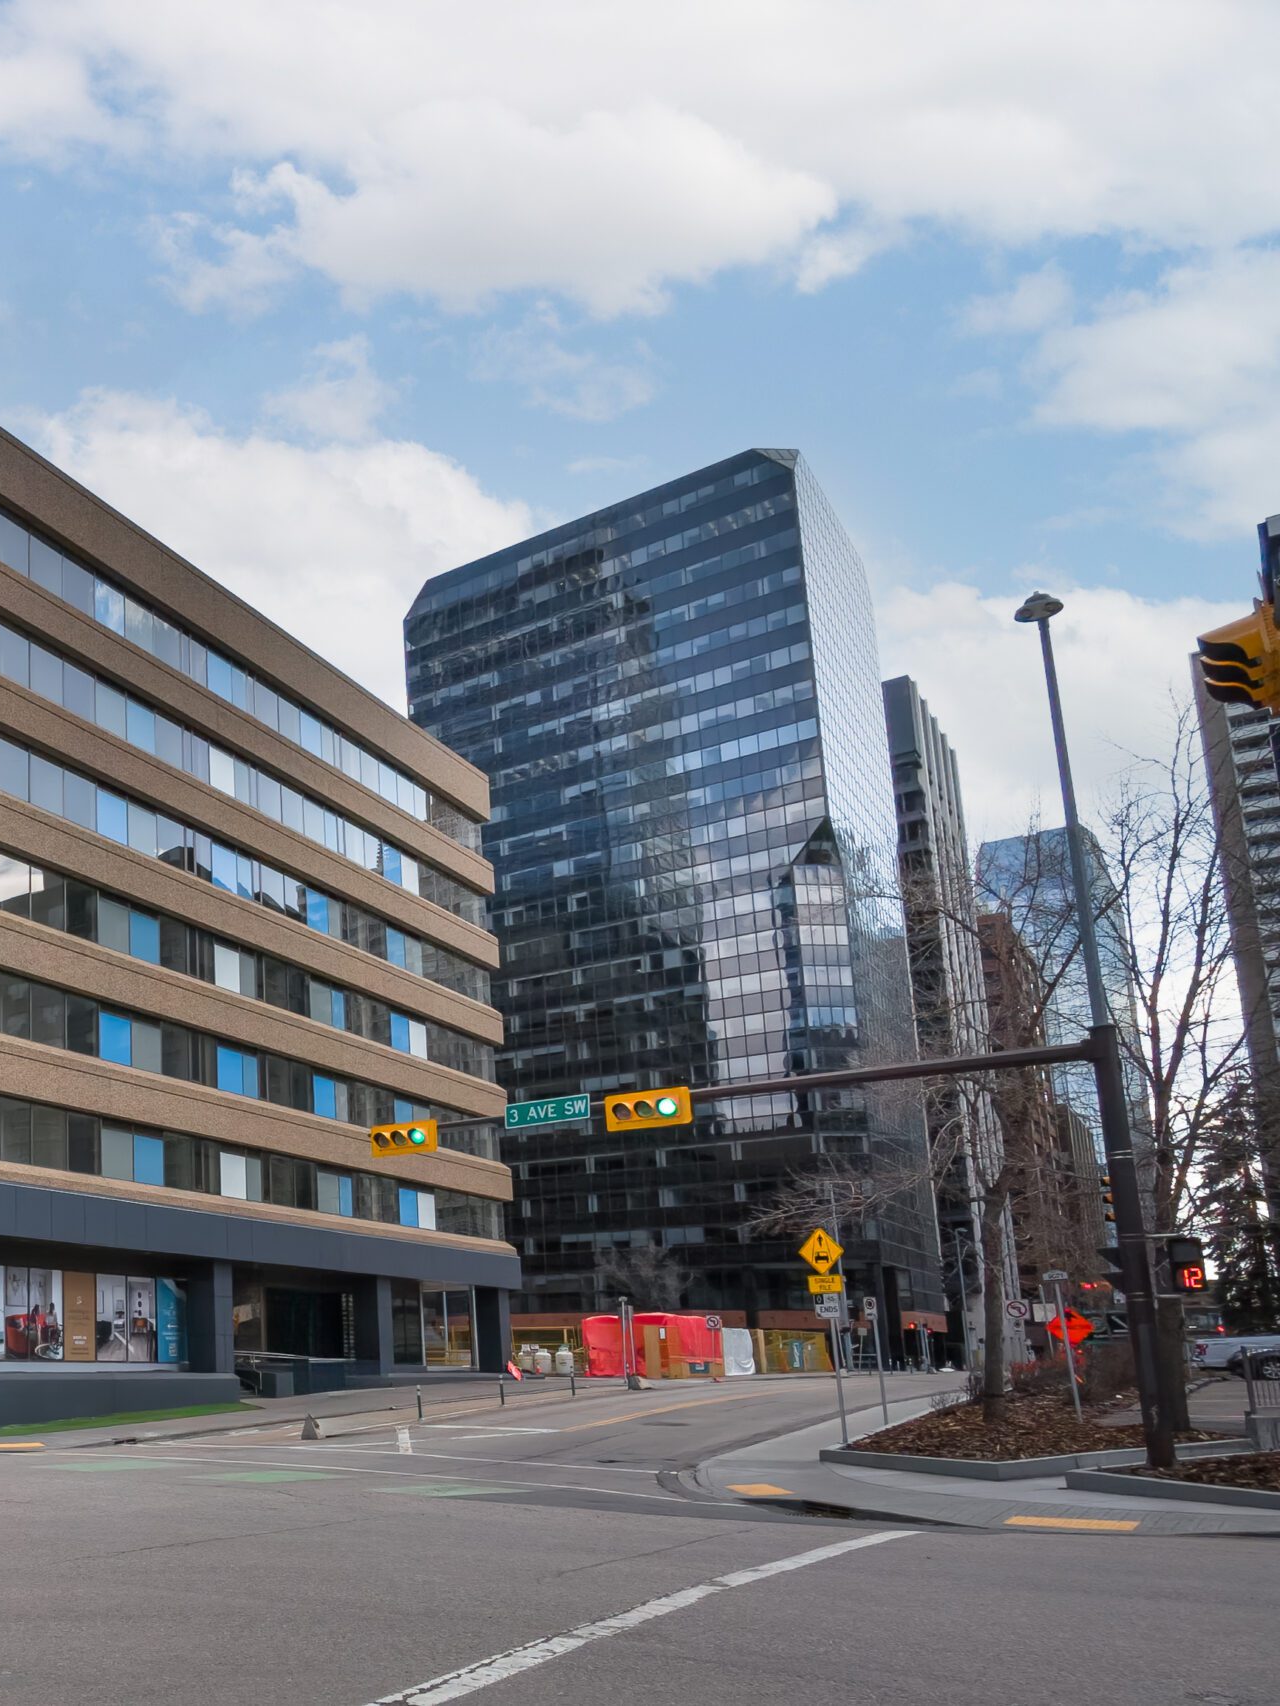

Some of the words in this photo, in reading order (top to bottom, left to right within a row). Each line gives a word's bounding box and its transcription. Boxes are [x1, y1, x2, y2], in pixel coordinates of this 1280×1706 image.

[509, 1109, 519, 1123] 3
[526, 1103, 557, 1120] AVE
[564, 1098, 587, 1115] SW
[1183, 1267, 1202, 1288] 12
[819, 1305, 839, 1313] ENDS
